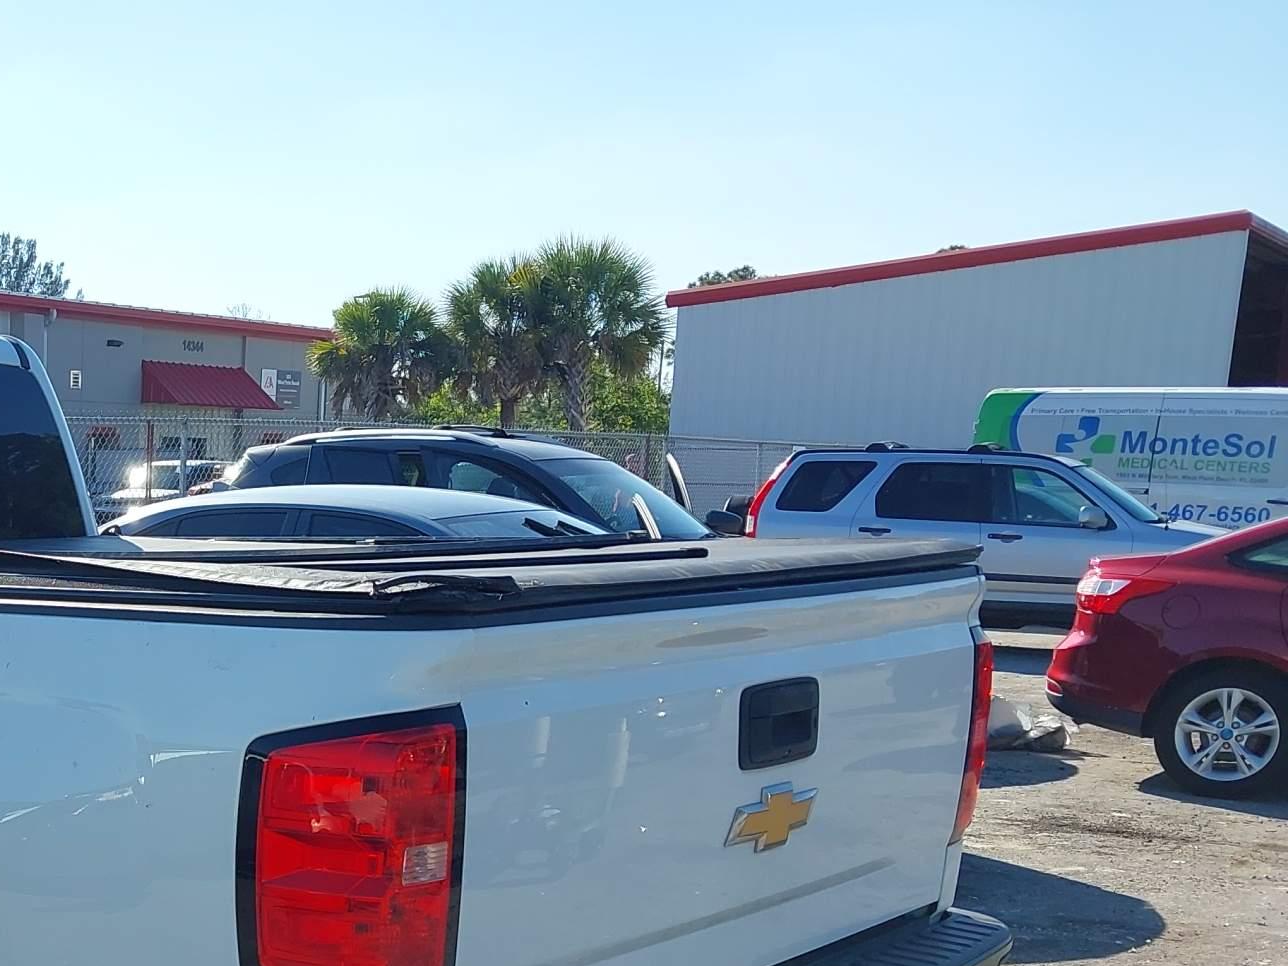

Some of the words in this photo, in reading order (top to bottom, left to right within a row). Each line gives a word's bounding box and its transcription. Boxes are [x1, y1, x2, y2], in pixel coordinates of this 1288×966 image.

[182, 339, 204, 353] 14344
[1120, 430, 1277, 459] MonteSol
[1117, 457, 1189, 471] MEDICAL
[1193, 458, 1271, 474] CENTERS
